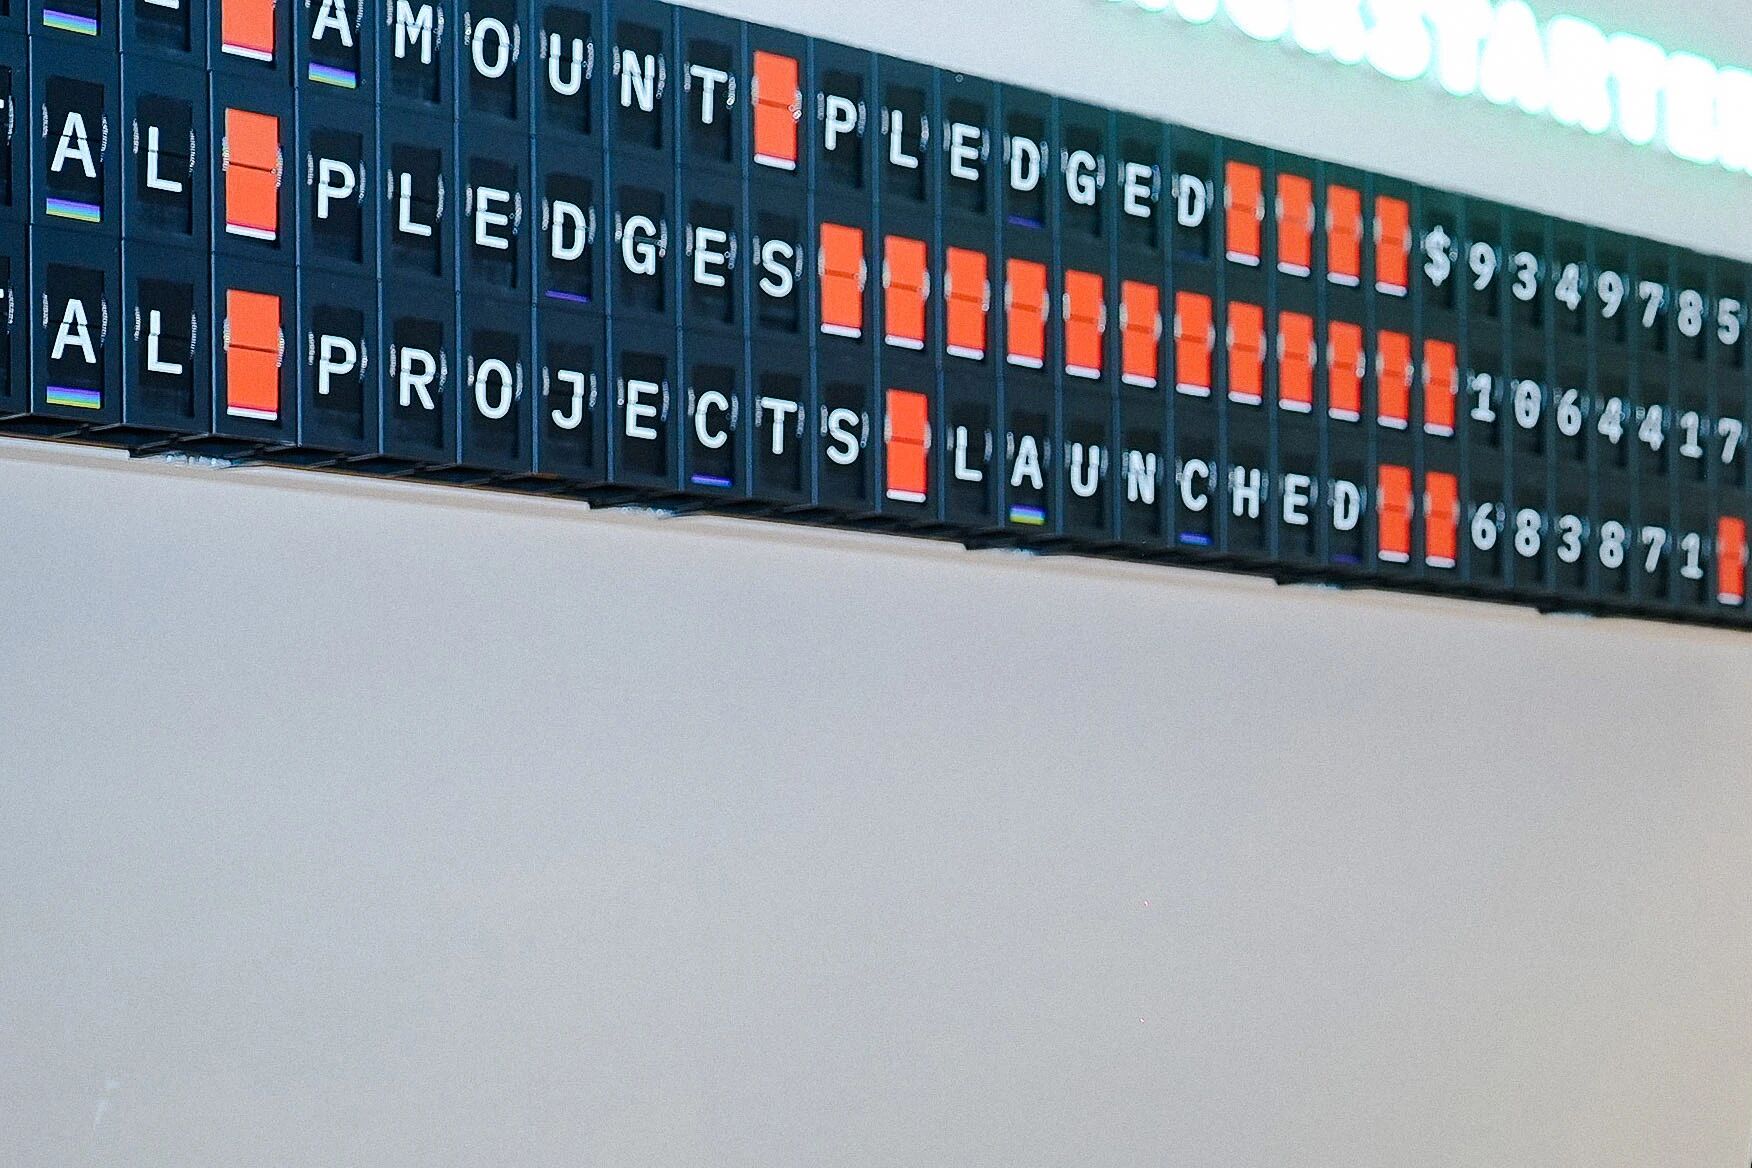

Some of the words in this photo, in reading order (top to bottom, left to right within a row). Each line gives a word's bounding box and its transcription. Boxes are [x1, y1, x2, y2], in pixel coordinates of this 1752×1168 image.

[0, 99, 184, 193] AL
[317, 157, 795, 299] PLEDGES
[310, 0, 731, 125] AMOUNT
[825, 94, 1206, 228] PLEDGED
[0, 288, 184, 375] AL
[318, 335, 862, 467] PROJECTS
[954, 425, 1361, 531] LAUNCHED
[1470, 506, 1704, 580] 683871
